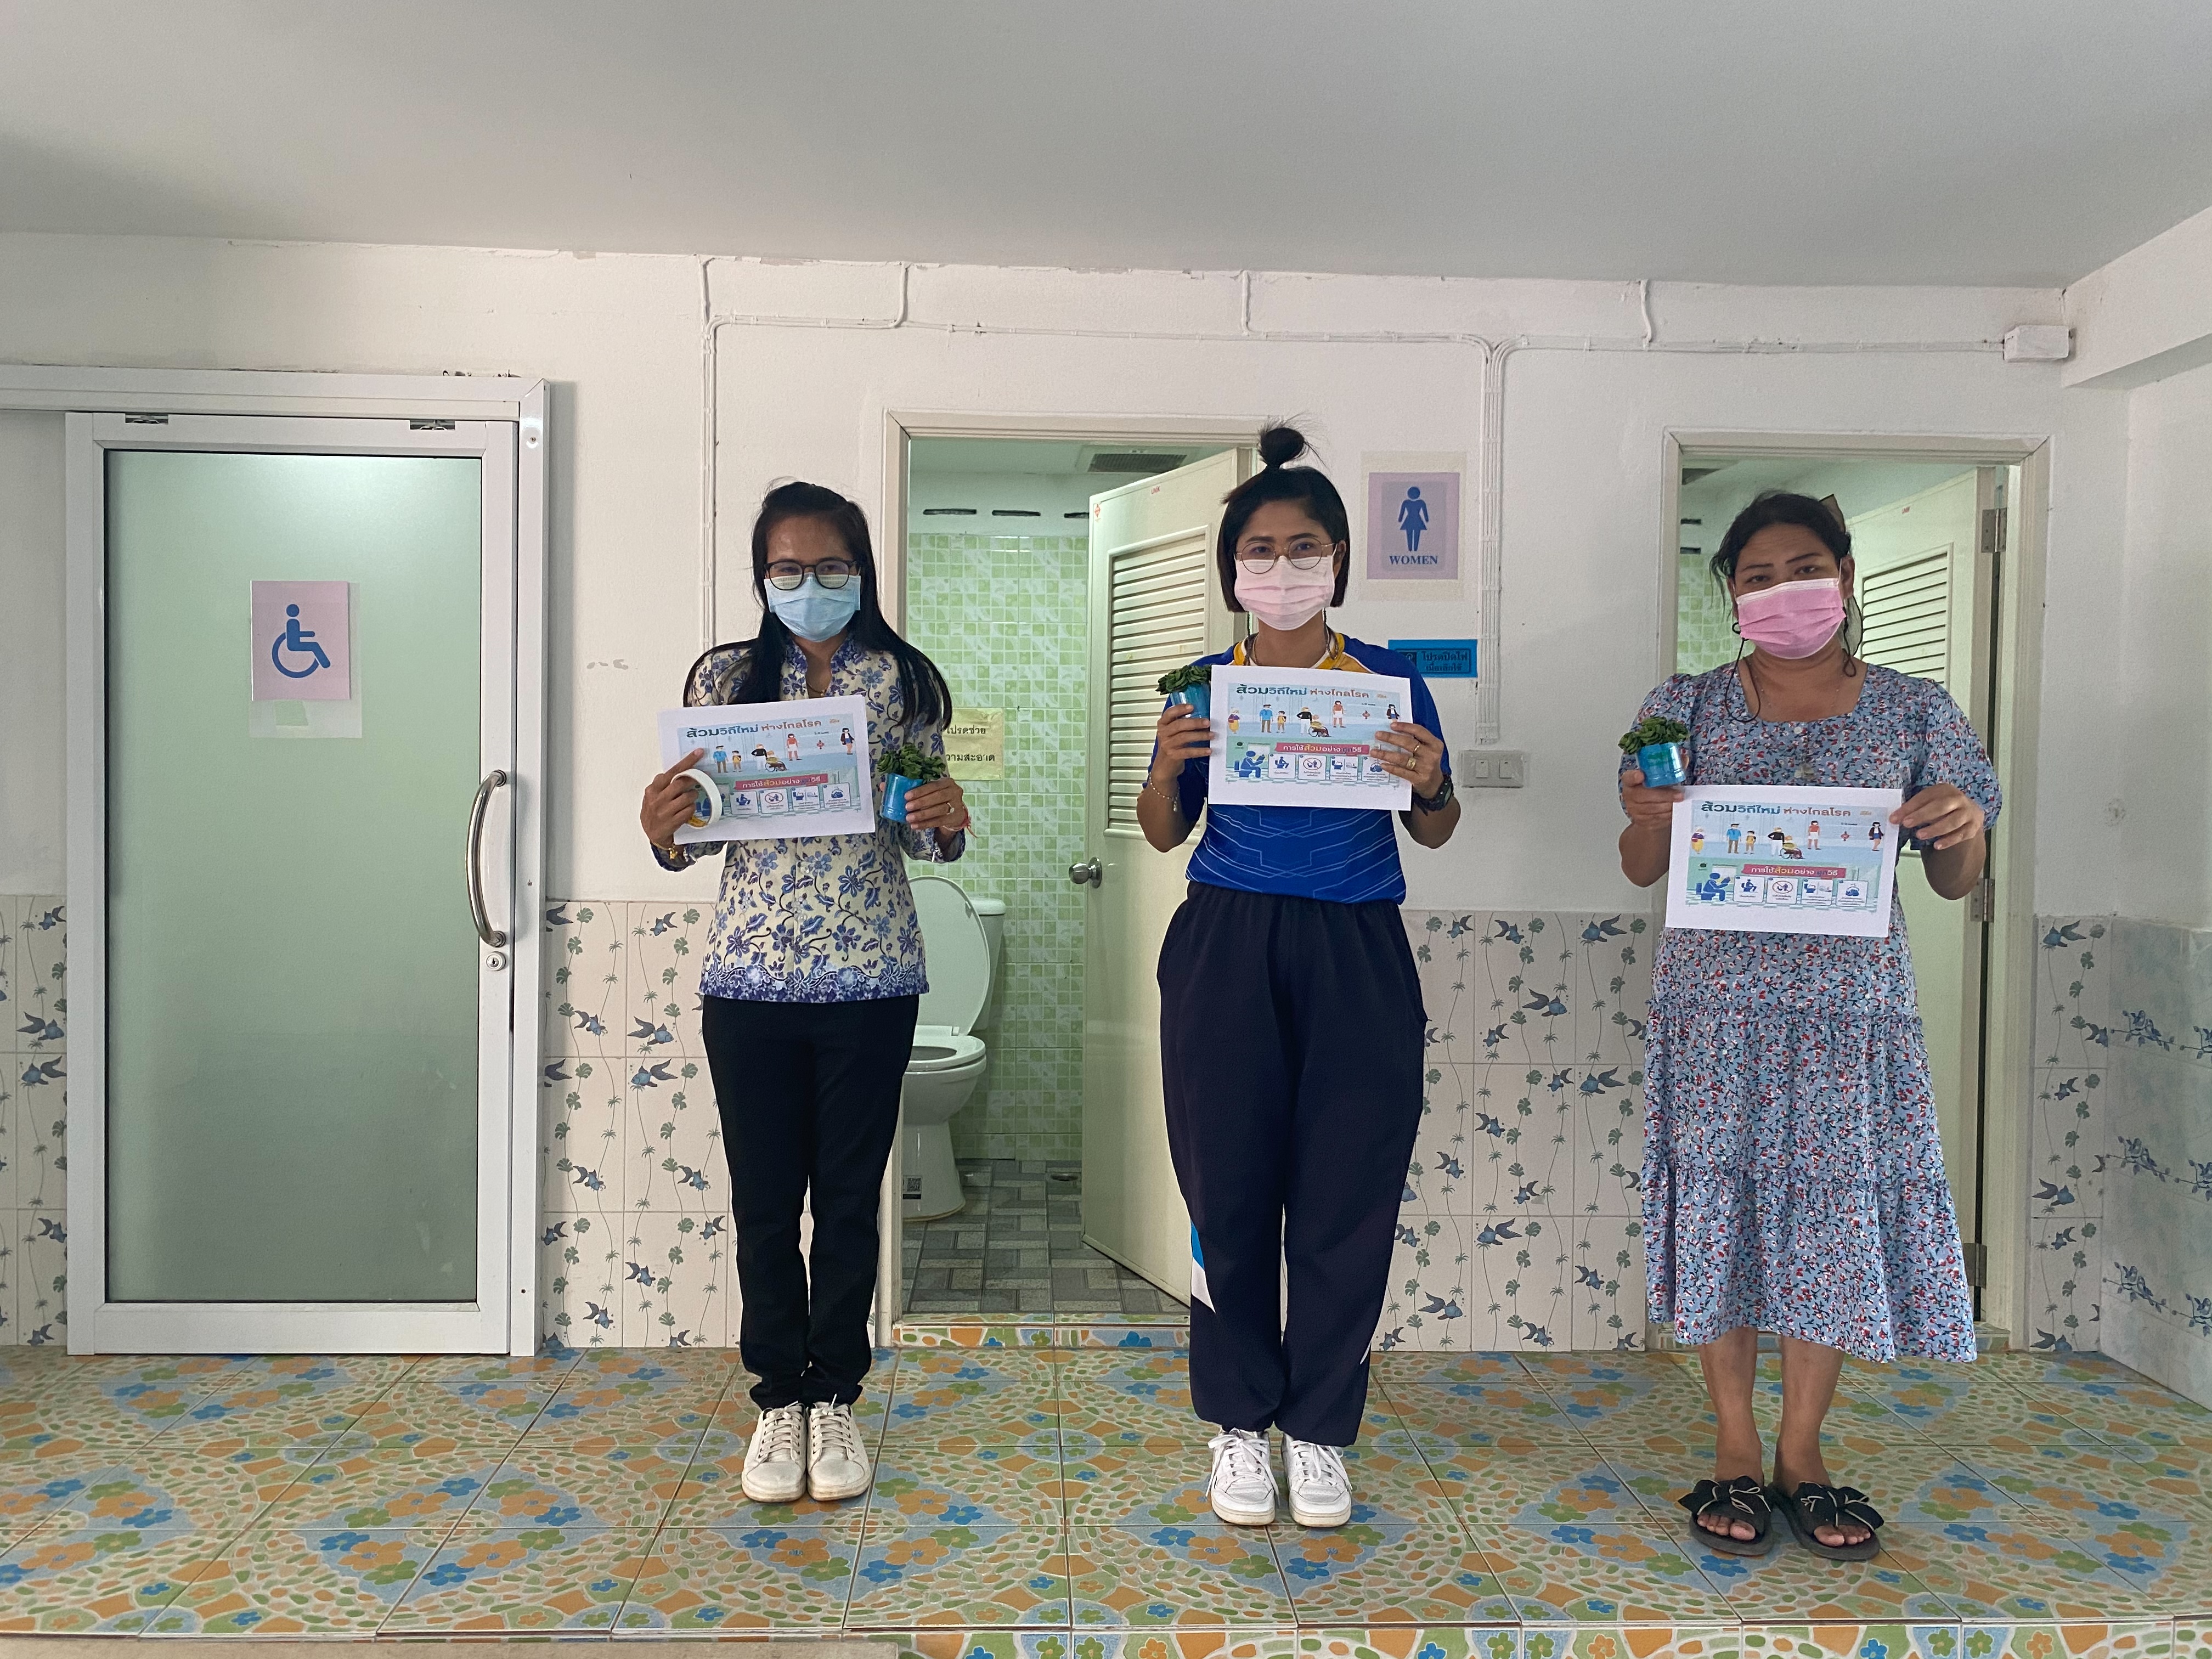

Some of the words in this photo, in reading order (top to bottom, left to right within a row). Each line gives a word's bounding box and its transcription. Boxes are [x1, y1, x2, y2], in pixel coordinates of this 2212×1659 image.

[1389, 555, 1438, 565] WOMEN
[946, 753, 995, 761] วามสะอาด
